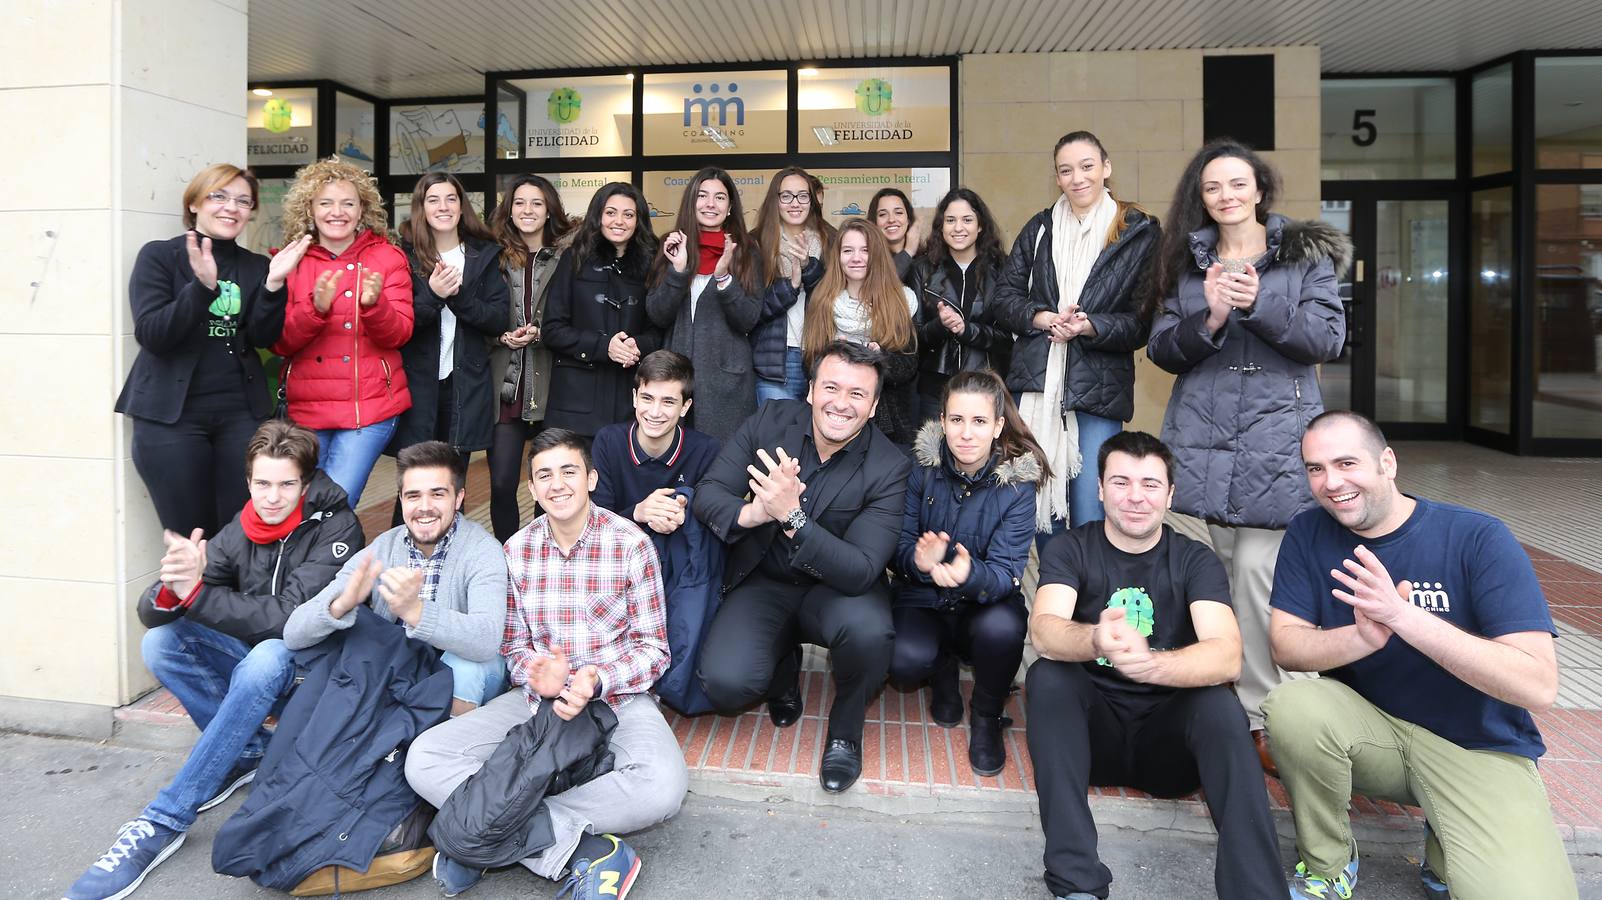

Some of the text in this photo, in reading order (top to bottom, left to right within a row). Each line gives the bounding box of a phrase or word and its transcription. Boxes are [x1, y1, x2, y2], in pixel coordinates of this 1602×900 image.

[833, 120, 912, 129] UNIVERSIDAD de la
[1352, 109, 1377, 147] 5
[528, 127, 581, 136] UNIVERSIDAD
[582, 127, 591, 135] de
[834, 129, 913, 141] FELICIDAD
[528, 135, 600, 147] FELICIDAD
[247, 143, 309, 155] FELICIDAD
[571, 177, 607, 188] Mental
[817, 173, 931, 184] Pensamiento lateral
[598, 870, 621, 896] N
